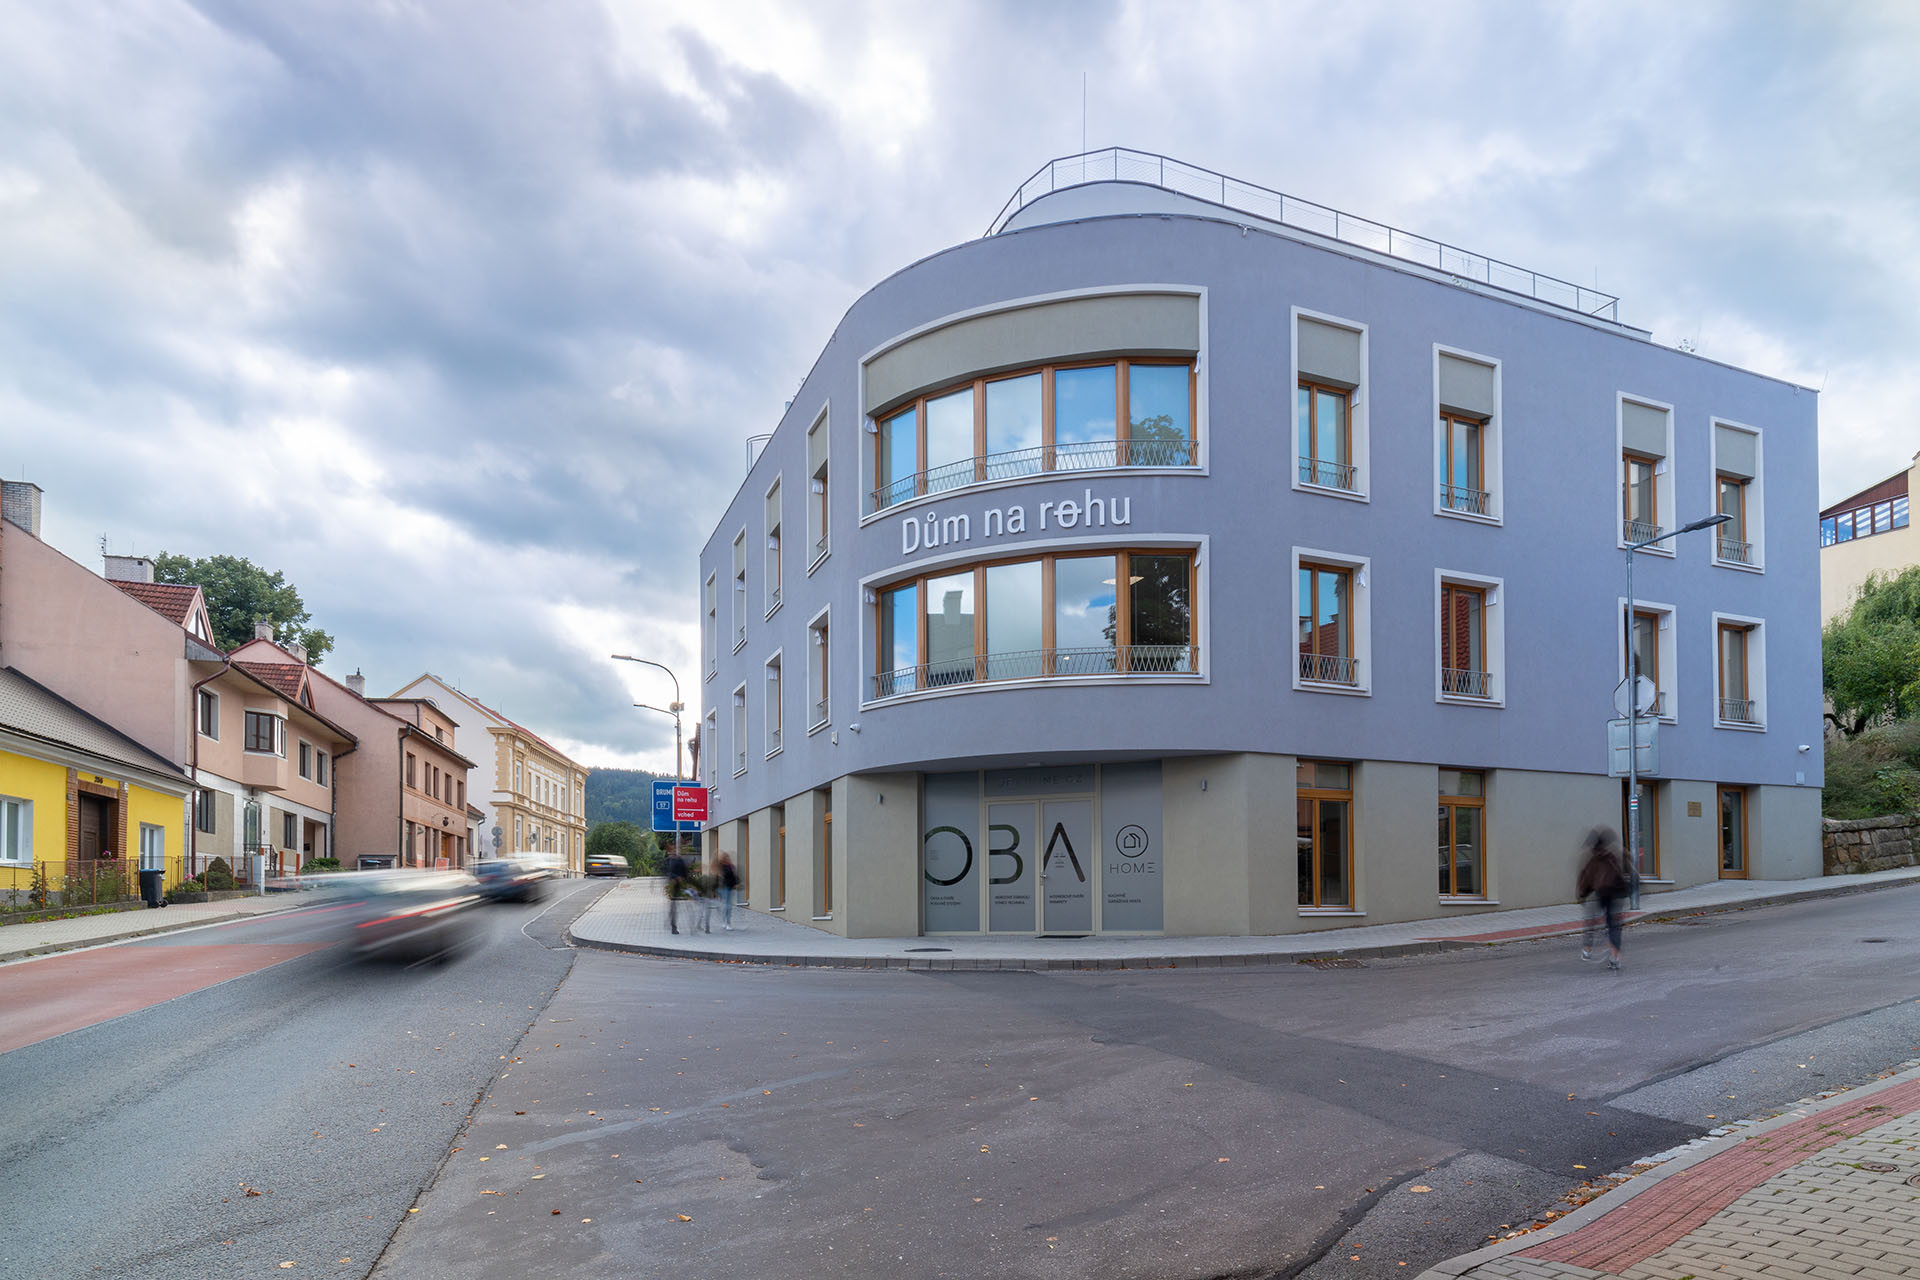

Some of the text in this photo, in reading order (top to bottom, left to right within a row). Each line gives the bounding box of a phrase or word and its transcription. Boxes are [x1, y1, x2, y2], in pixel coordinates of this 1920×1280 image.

[902, 488, 1131, 555] Dům na rohu
[1109, 861, 1156, 875] HOME
